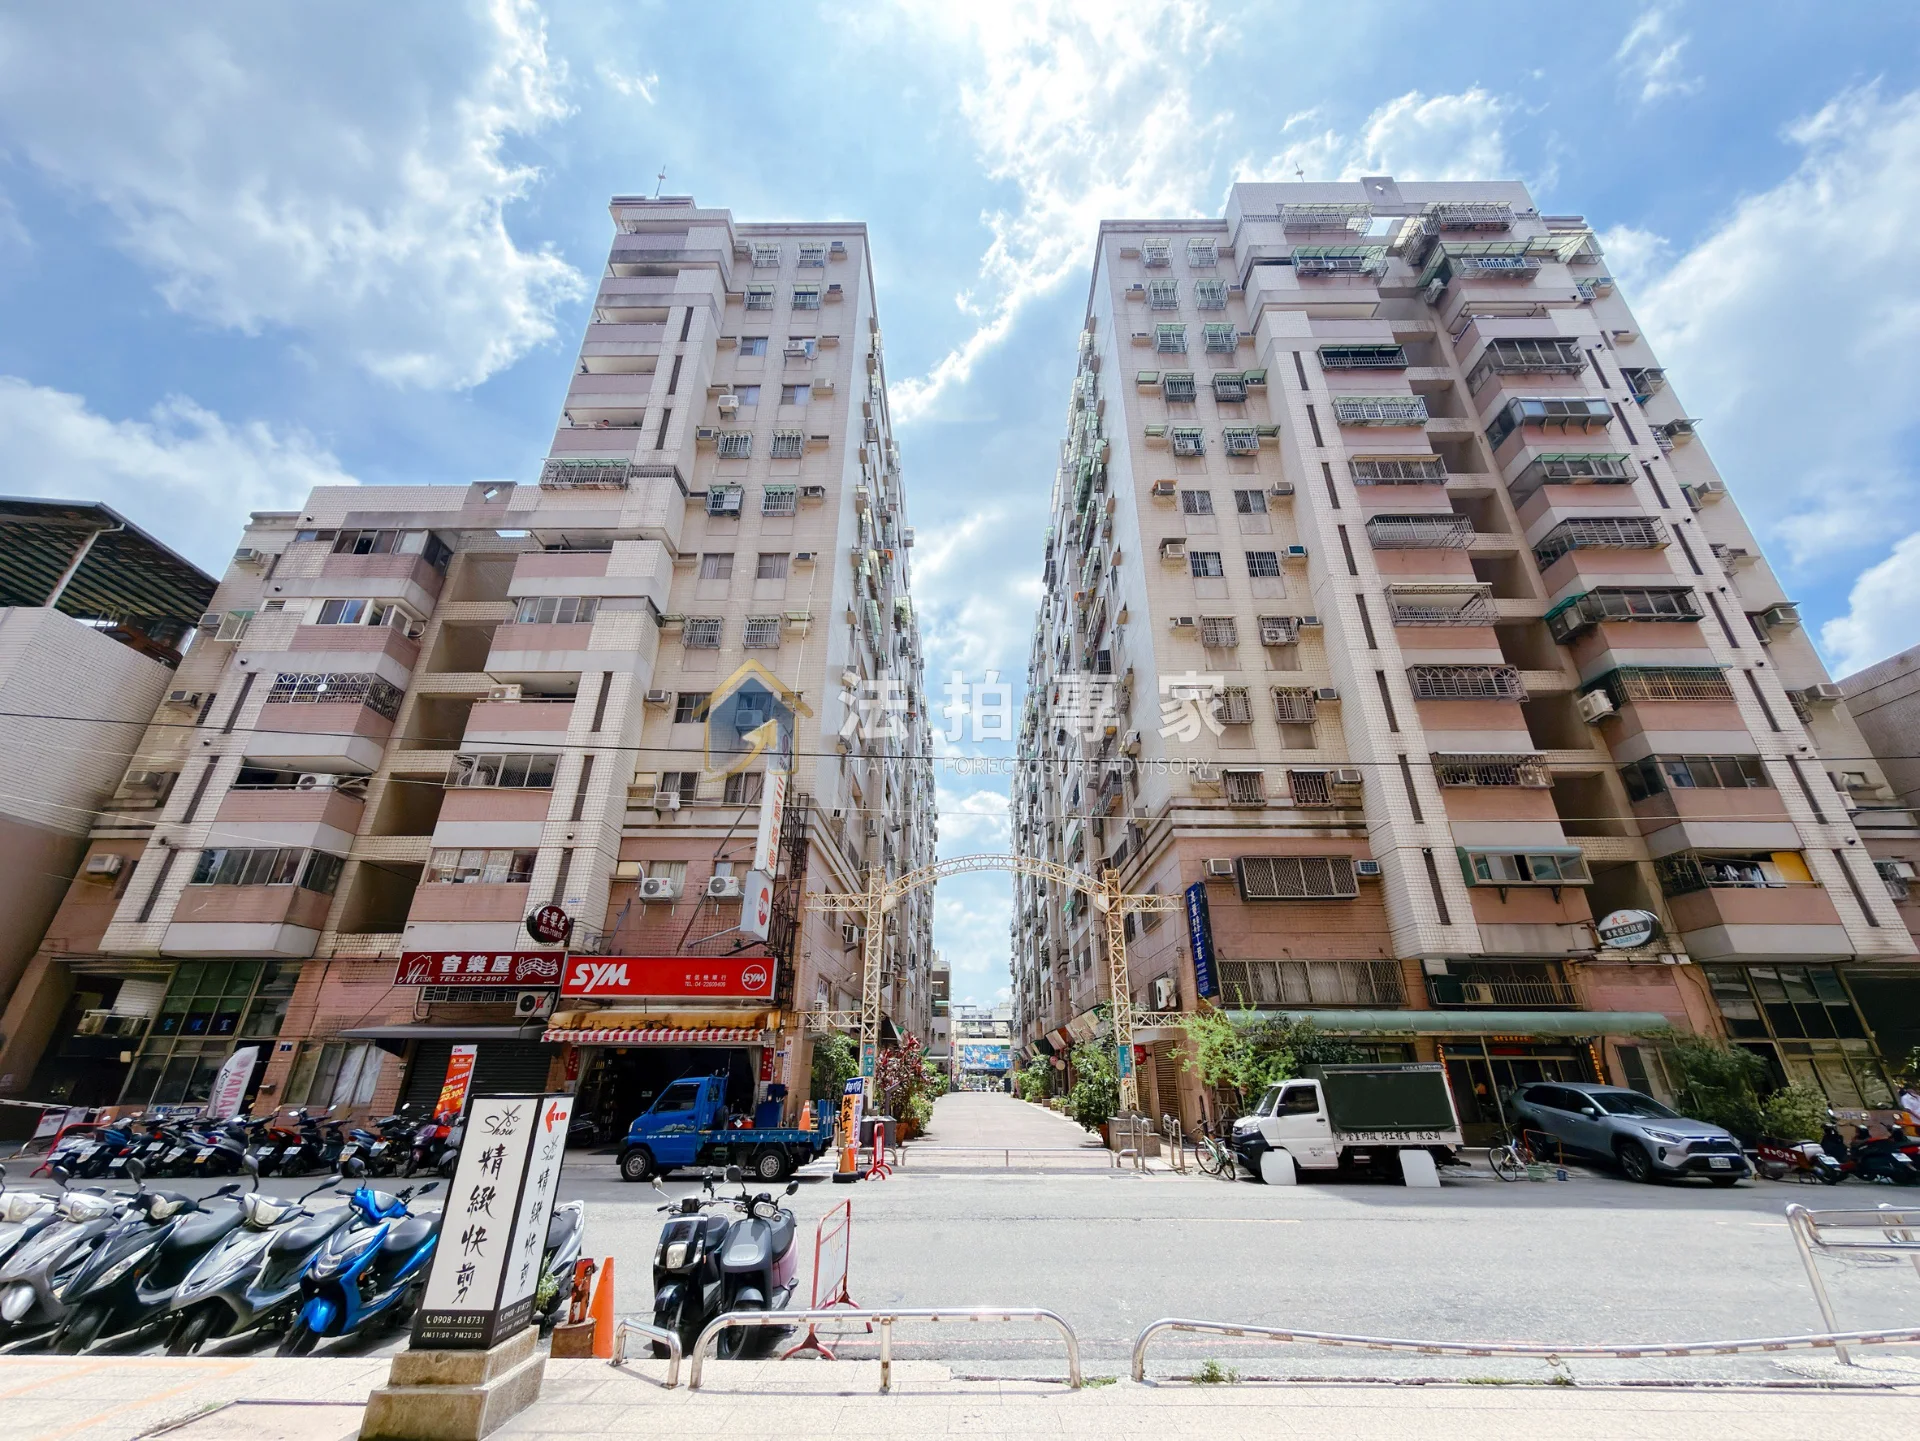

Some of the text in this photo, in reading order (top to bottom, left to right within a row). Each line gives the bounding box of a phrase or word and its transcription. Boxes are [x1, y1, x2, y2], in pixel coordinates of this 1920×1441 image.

[542, 909, 566, 931] 音樂屋
[441, 954, 513, 973] 音樂屋
[568, 963, 631, 993] SYM
[742, 973, 766, 985] SYM
[215, 1070, 245, 1119] YAMAH
[452, 1143, 509, 1304] 精緻快剪
